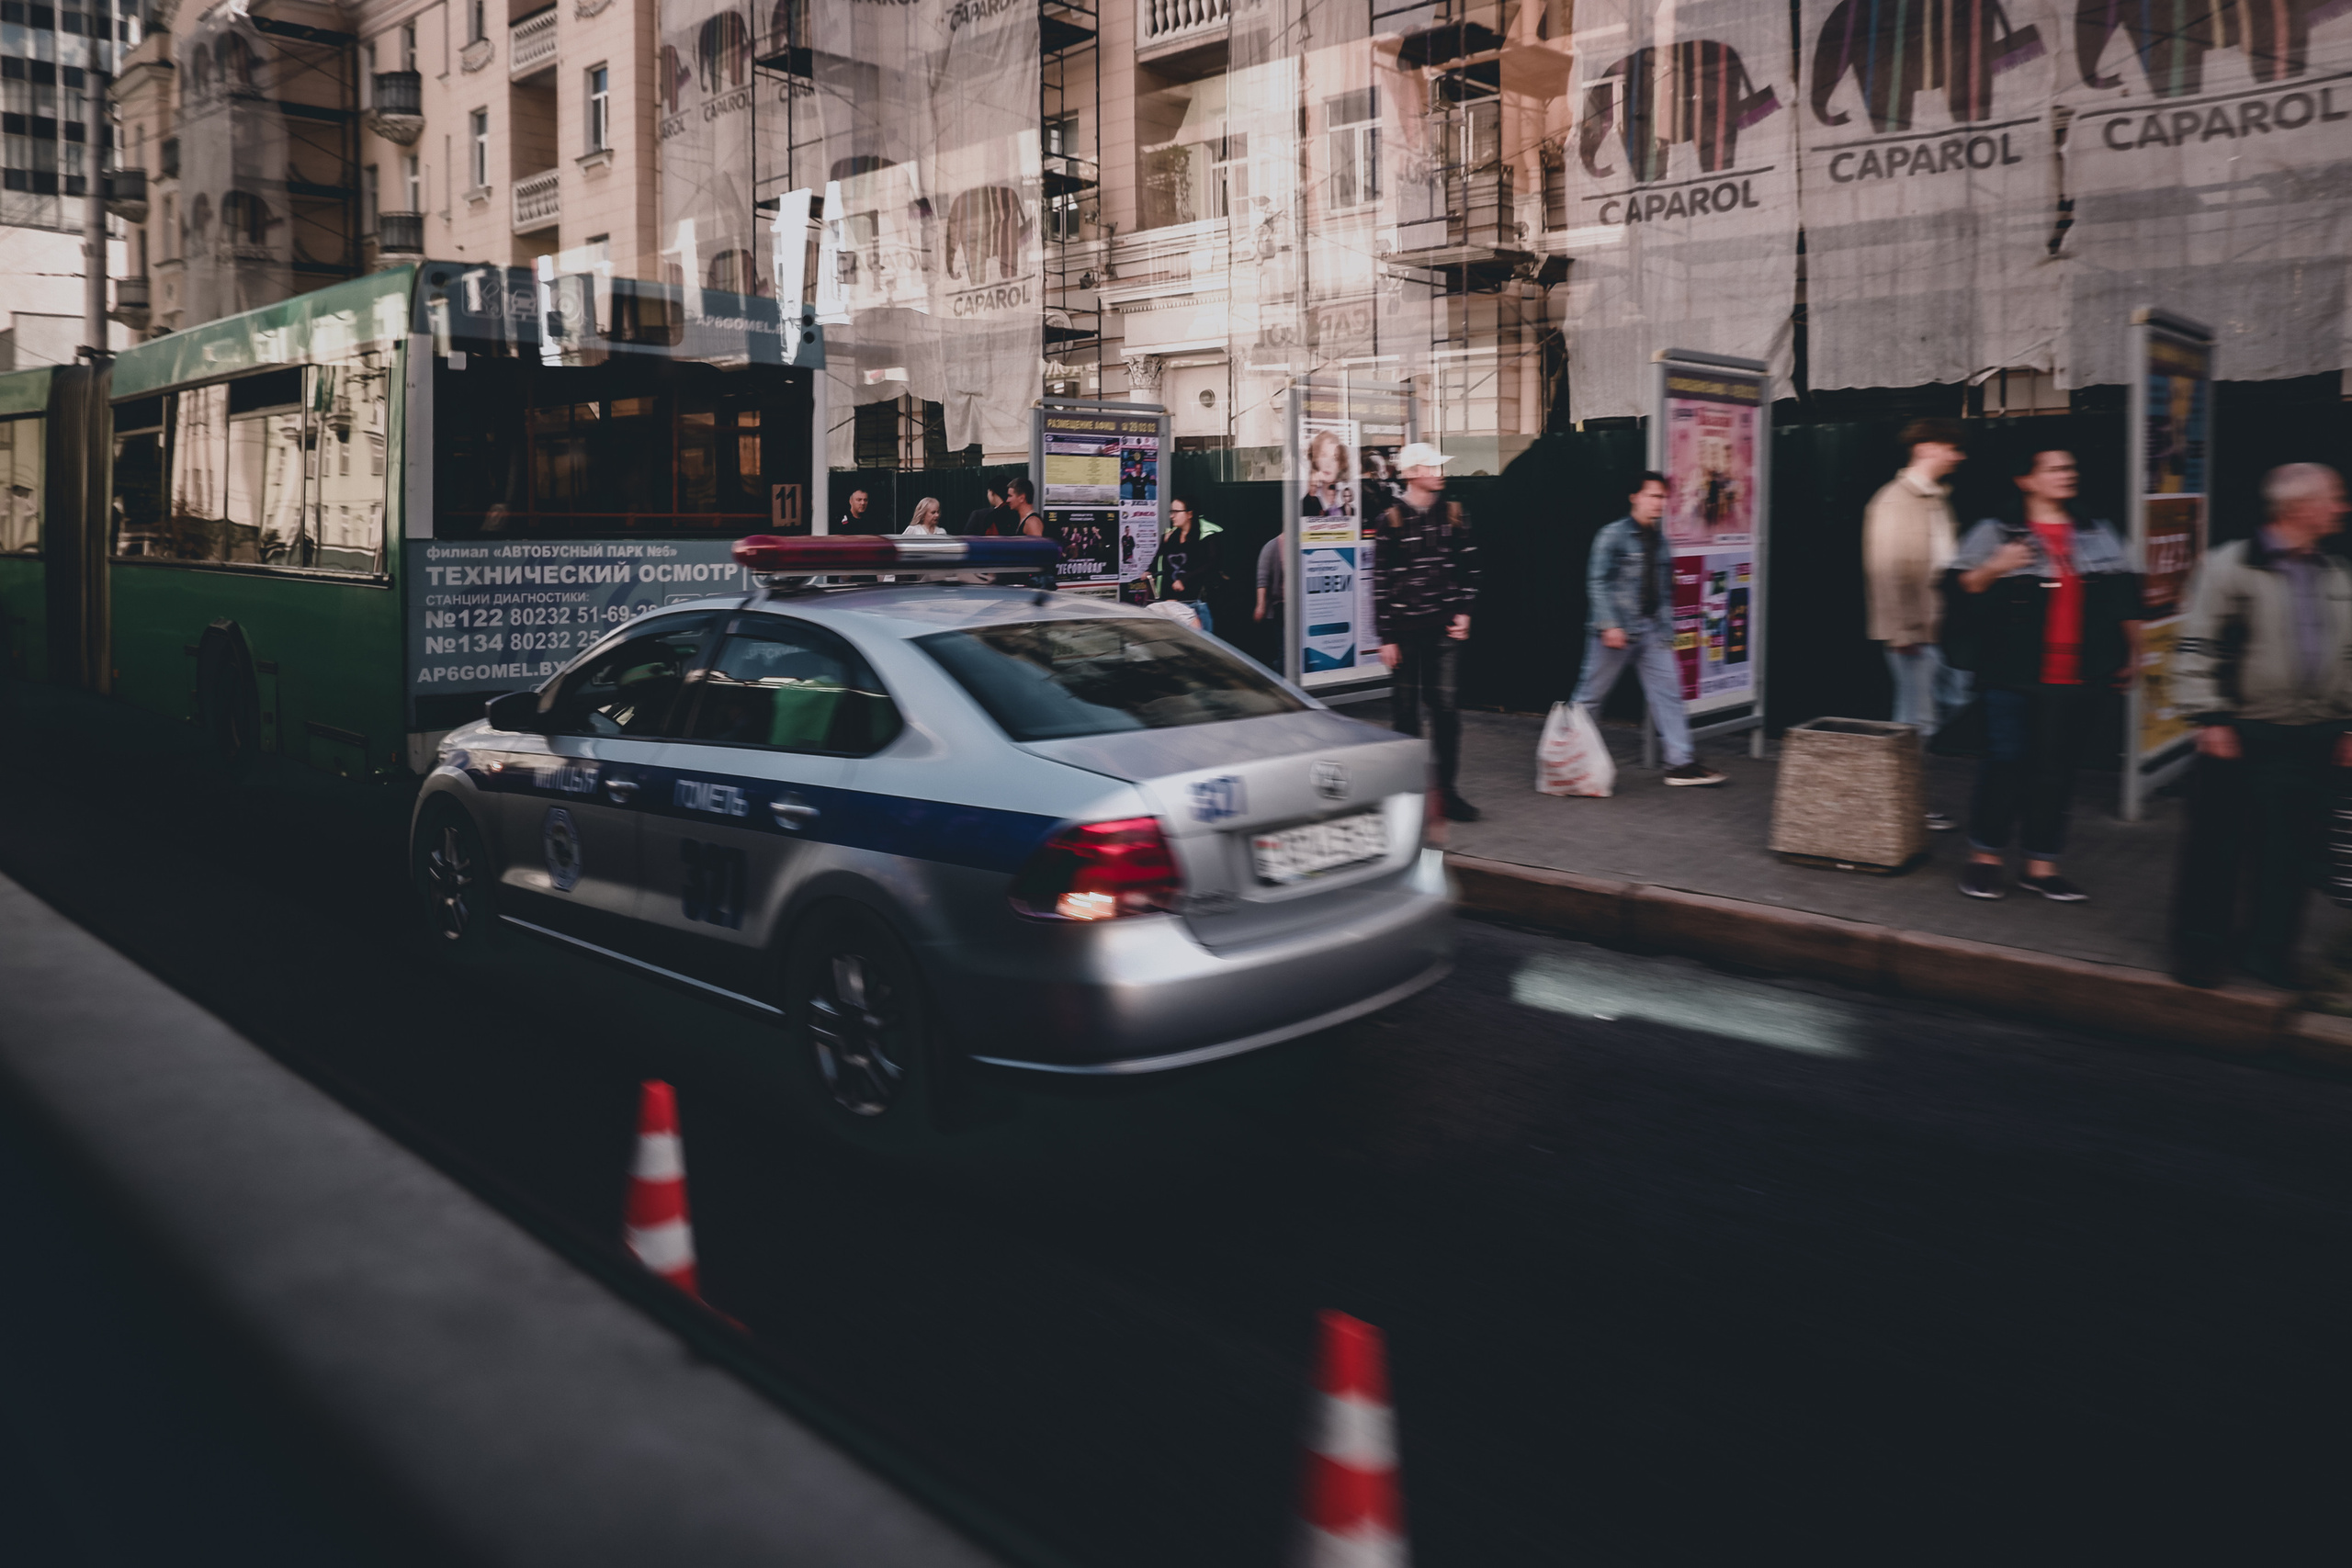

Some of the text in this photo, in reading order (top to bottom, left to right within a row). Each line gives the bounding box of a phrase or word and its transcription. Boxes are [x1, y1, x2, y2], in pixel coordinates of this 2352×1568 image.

[2102, 87, 2349, 152] CAPAROL
[1829, 132, 2022, 183] CAPAROL
[1599, 179, 1759, 226] CAPAROL
[953, 284, 1031, 317] CAPAROL
[775, 486, 797, 519] 11
[426, 544, 677, 560] филиал «АВТОБУСНЫЙ ПАРК №6»
[425, 561, 739, 586] ТЕХНИЧЕСКИЙ ОСМОТР
[425, 592, 590, 606] СТАНЦИИ ДИАГНОСТИКИ:
[425, 609, 503, 629] №122
[510, 607, 571, 626] 80232
[425, 634, 503, 654] №134
[510, 631, 571, 650] 80232
